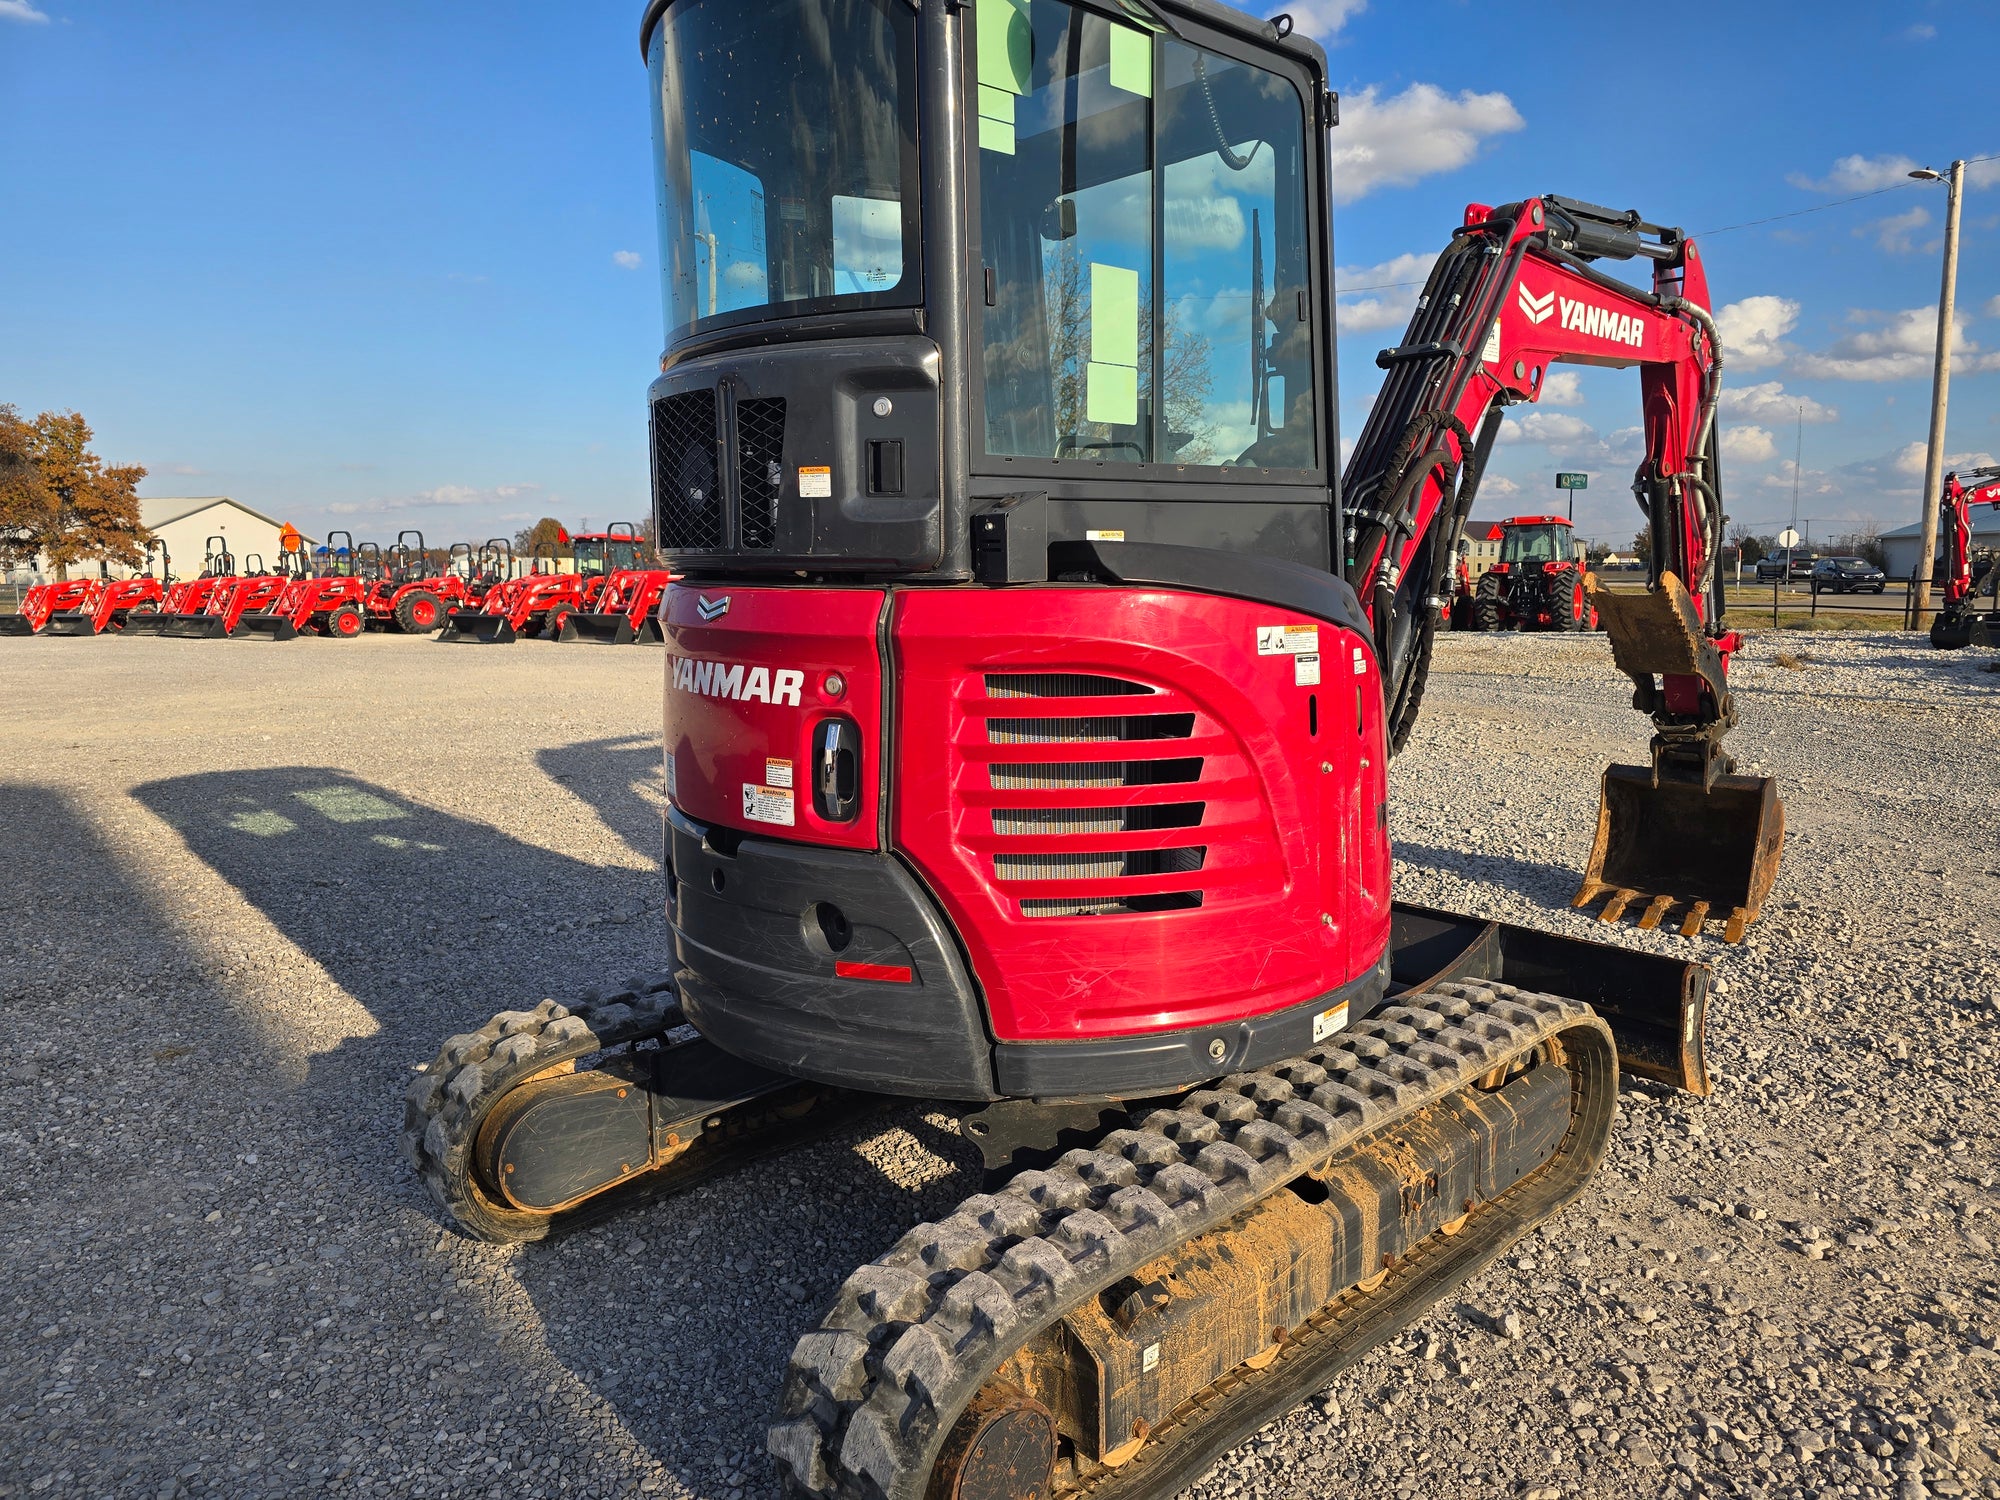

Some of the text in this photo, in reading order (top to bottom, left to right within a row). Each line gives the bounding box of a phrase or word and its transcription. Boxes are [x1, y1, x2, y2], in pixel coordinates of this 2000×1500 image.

[1560, 296, 1645, 348] YANMAR
[672, 655, 805, 707] YANMAR
[765, 789, 787, 797] WARNING
